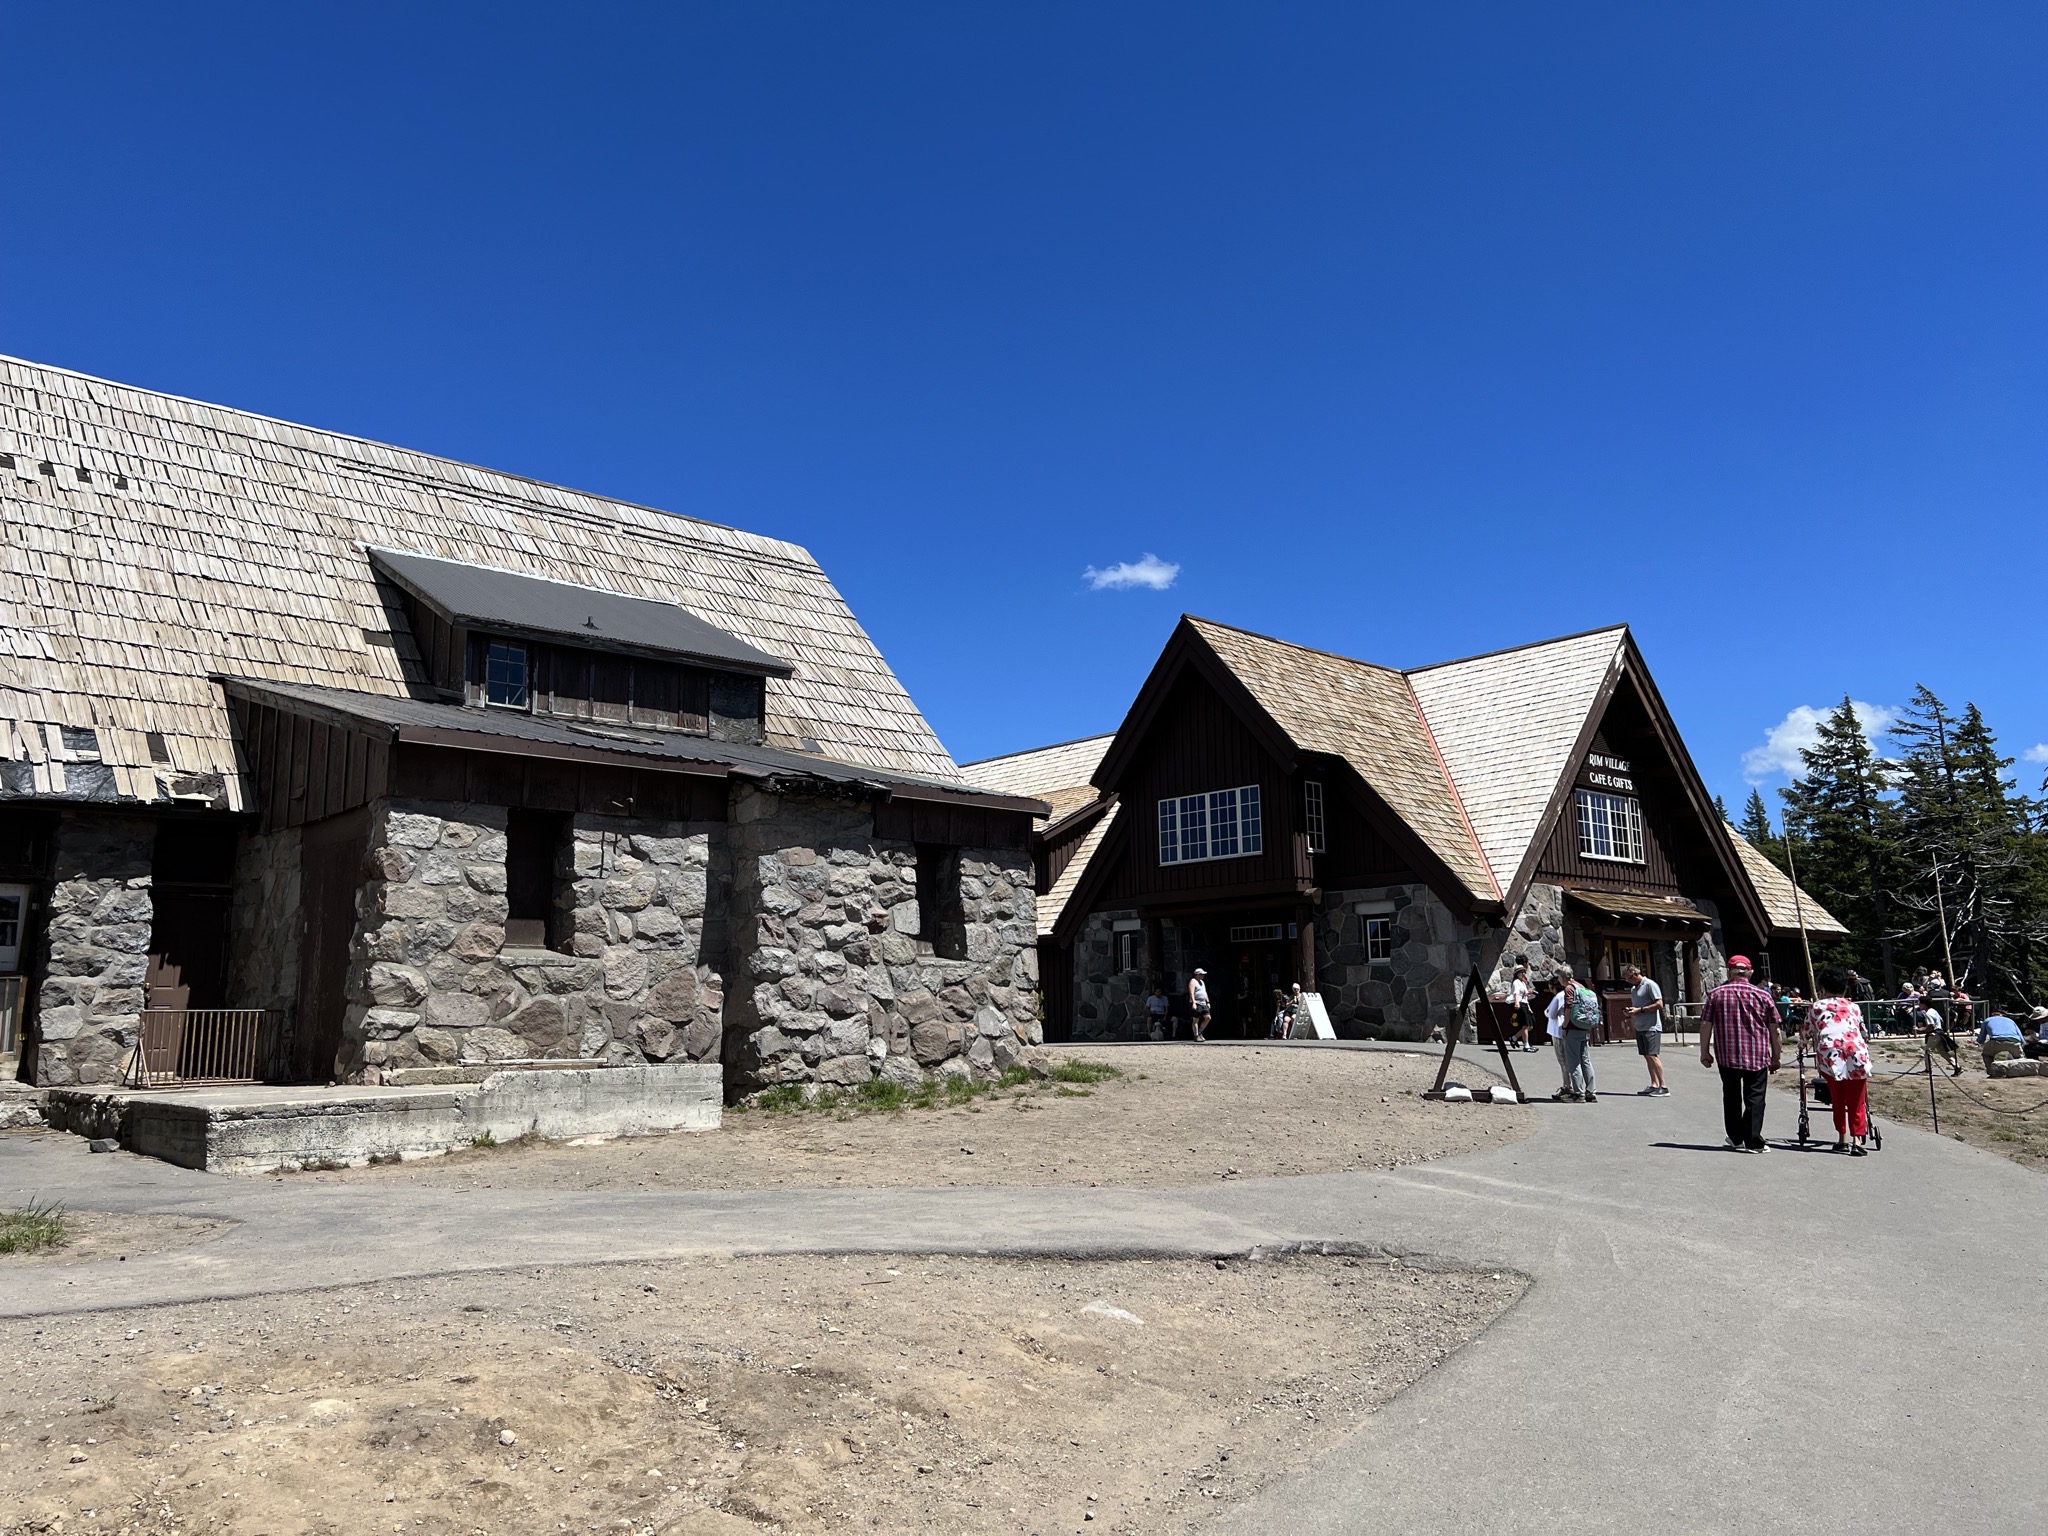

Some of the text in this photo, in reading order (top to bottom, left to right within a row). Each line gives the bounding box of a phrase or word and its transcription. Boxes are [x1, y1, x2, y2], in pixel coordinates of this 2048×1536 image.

[1589, 753, 1630, 772] RIM VILLAGE
[1589, 772, 1633, 791] CAFE & GIFTS
